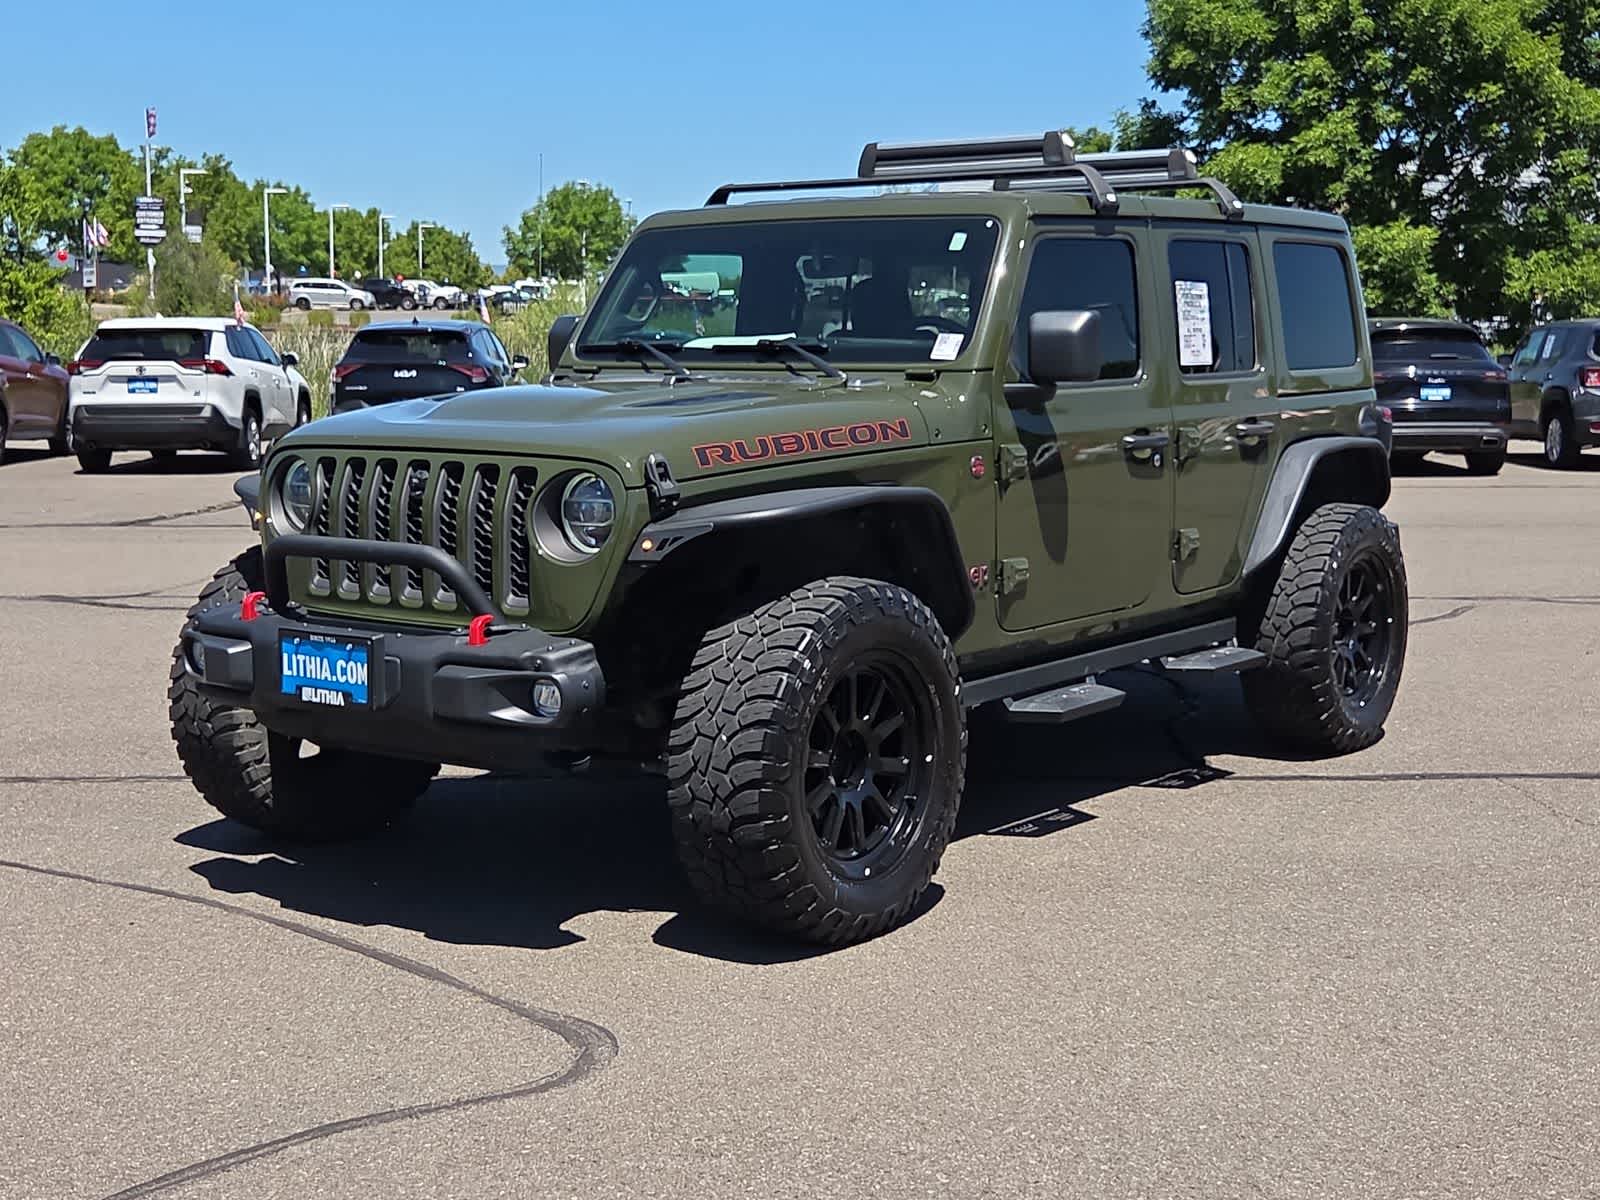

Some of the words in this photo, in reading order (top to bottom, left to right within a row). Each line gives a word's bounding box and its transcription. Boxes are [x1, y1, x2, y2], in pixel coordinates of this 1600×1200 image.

[692, 418, 912, 468] RUBICON
[282, 652, 368, 687] LITHIA.COM
[311, 687, 345, 707] LITHIA
